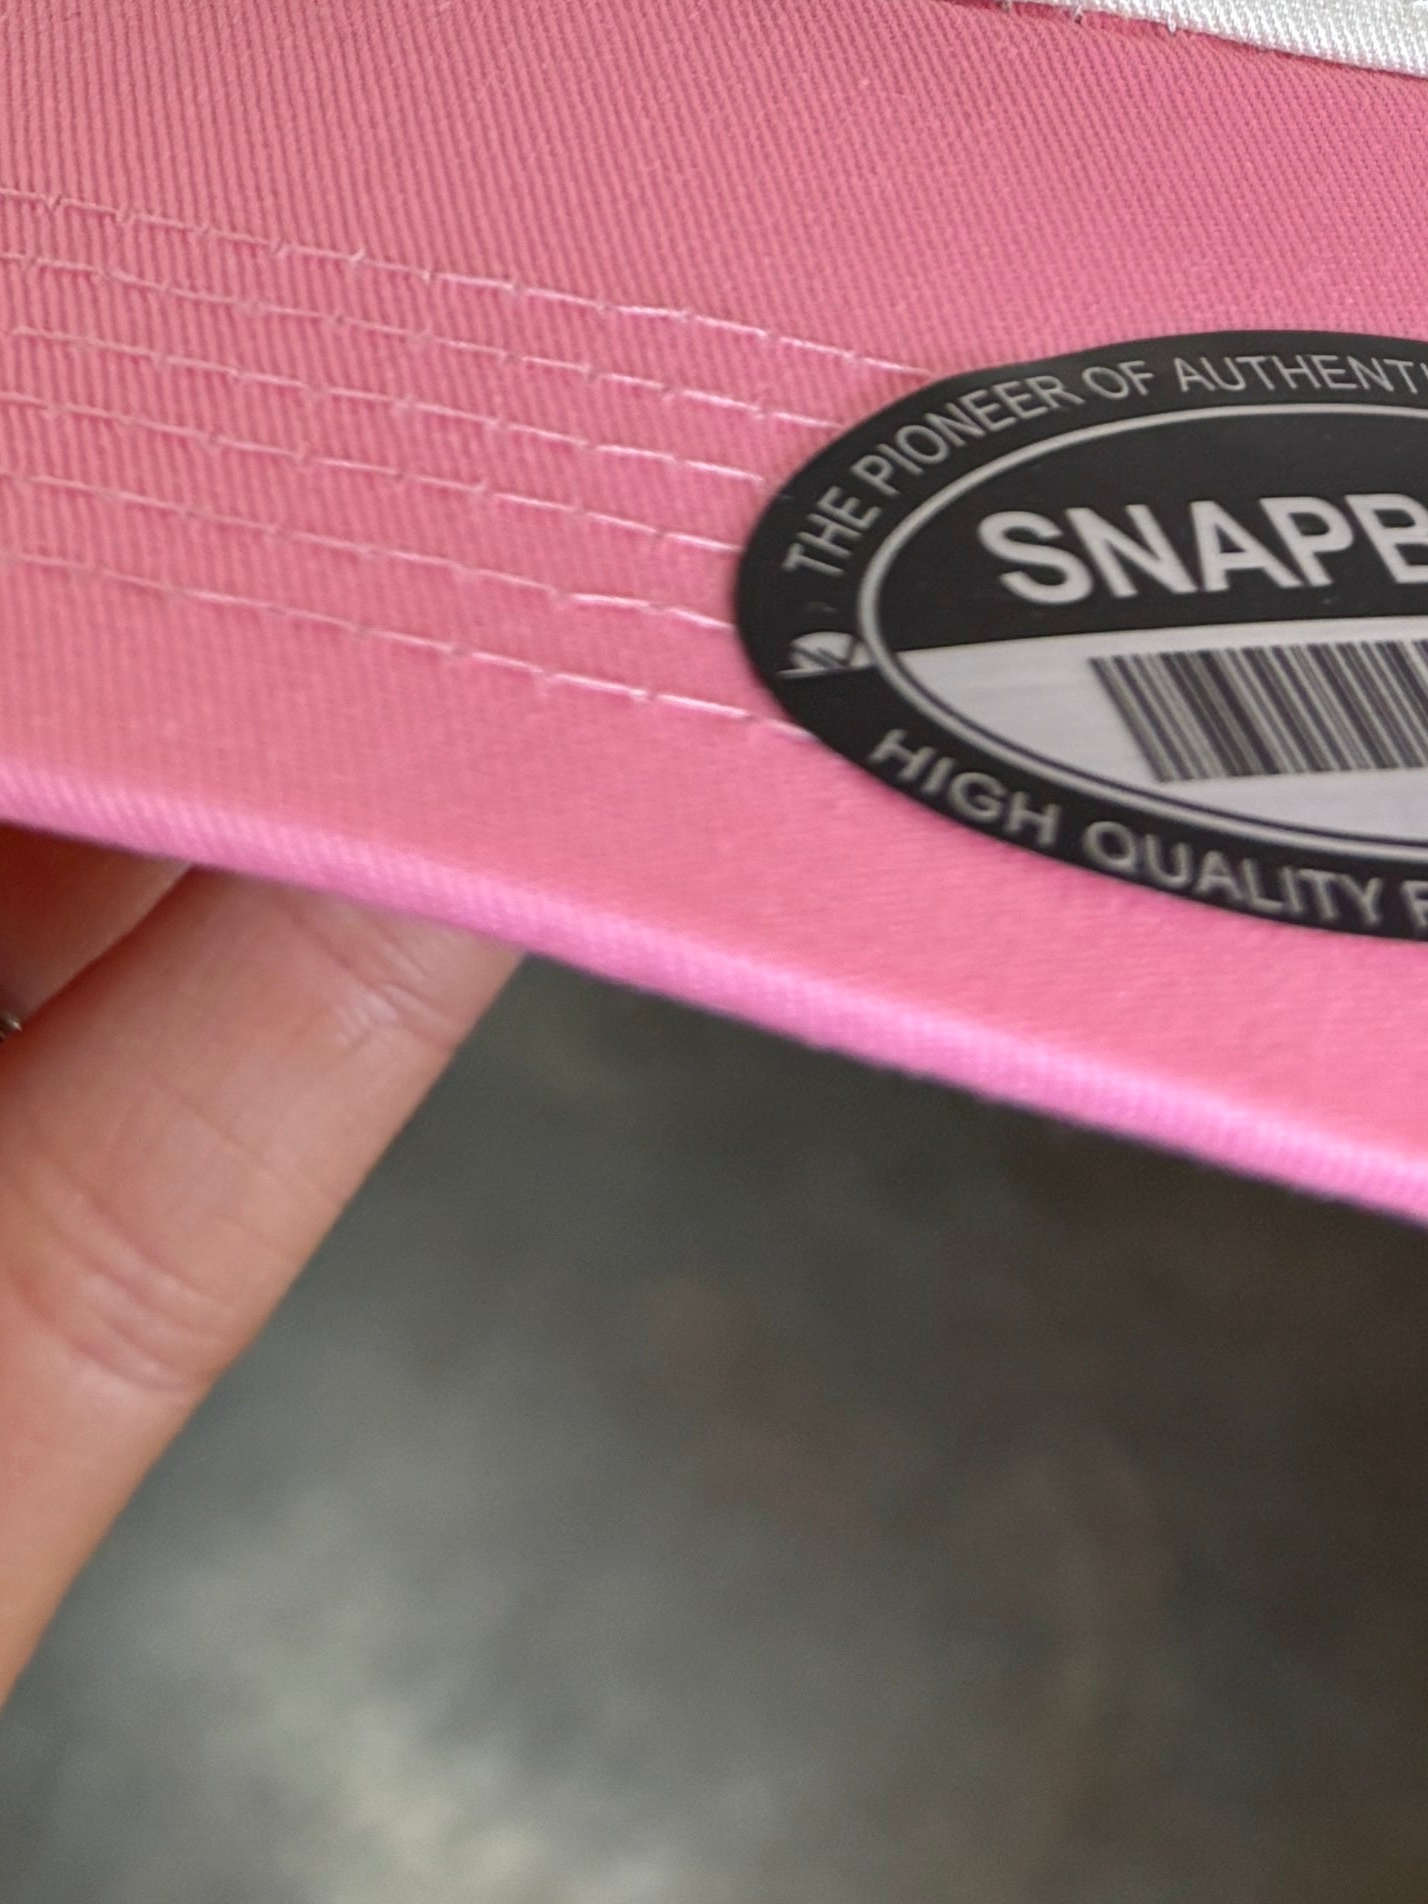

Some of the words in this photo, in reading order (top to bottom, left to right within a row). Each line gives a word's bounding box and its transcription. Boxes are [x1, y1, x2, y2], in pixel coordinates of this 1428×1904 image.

[783, 486, 882, 578] THE
[851, 374, 1084, 496] PIONEER
[1082, 360, 1155, 399] OF
[869, 728, 1062, 847] HIGH
[1082, 820, 1385, 926] QUALITY
